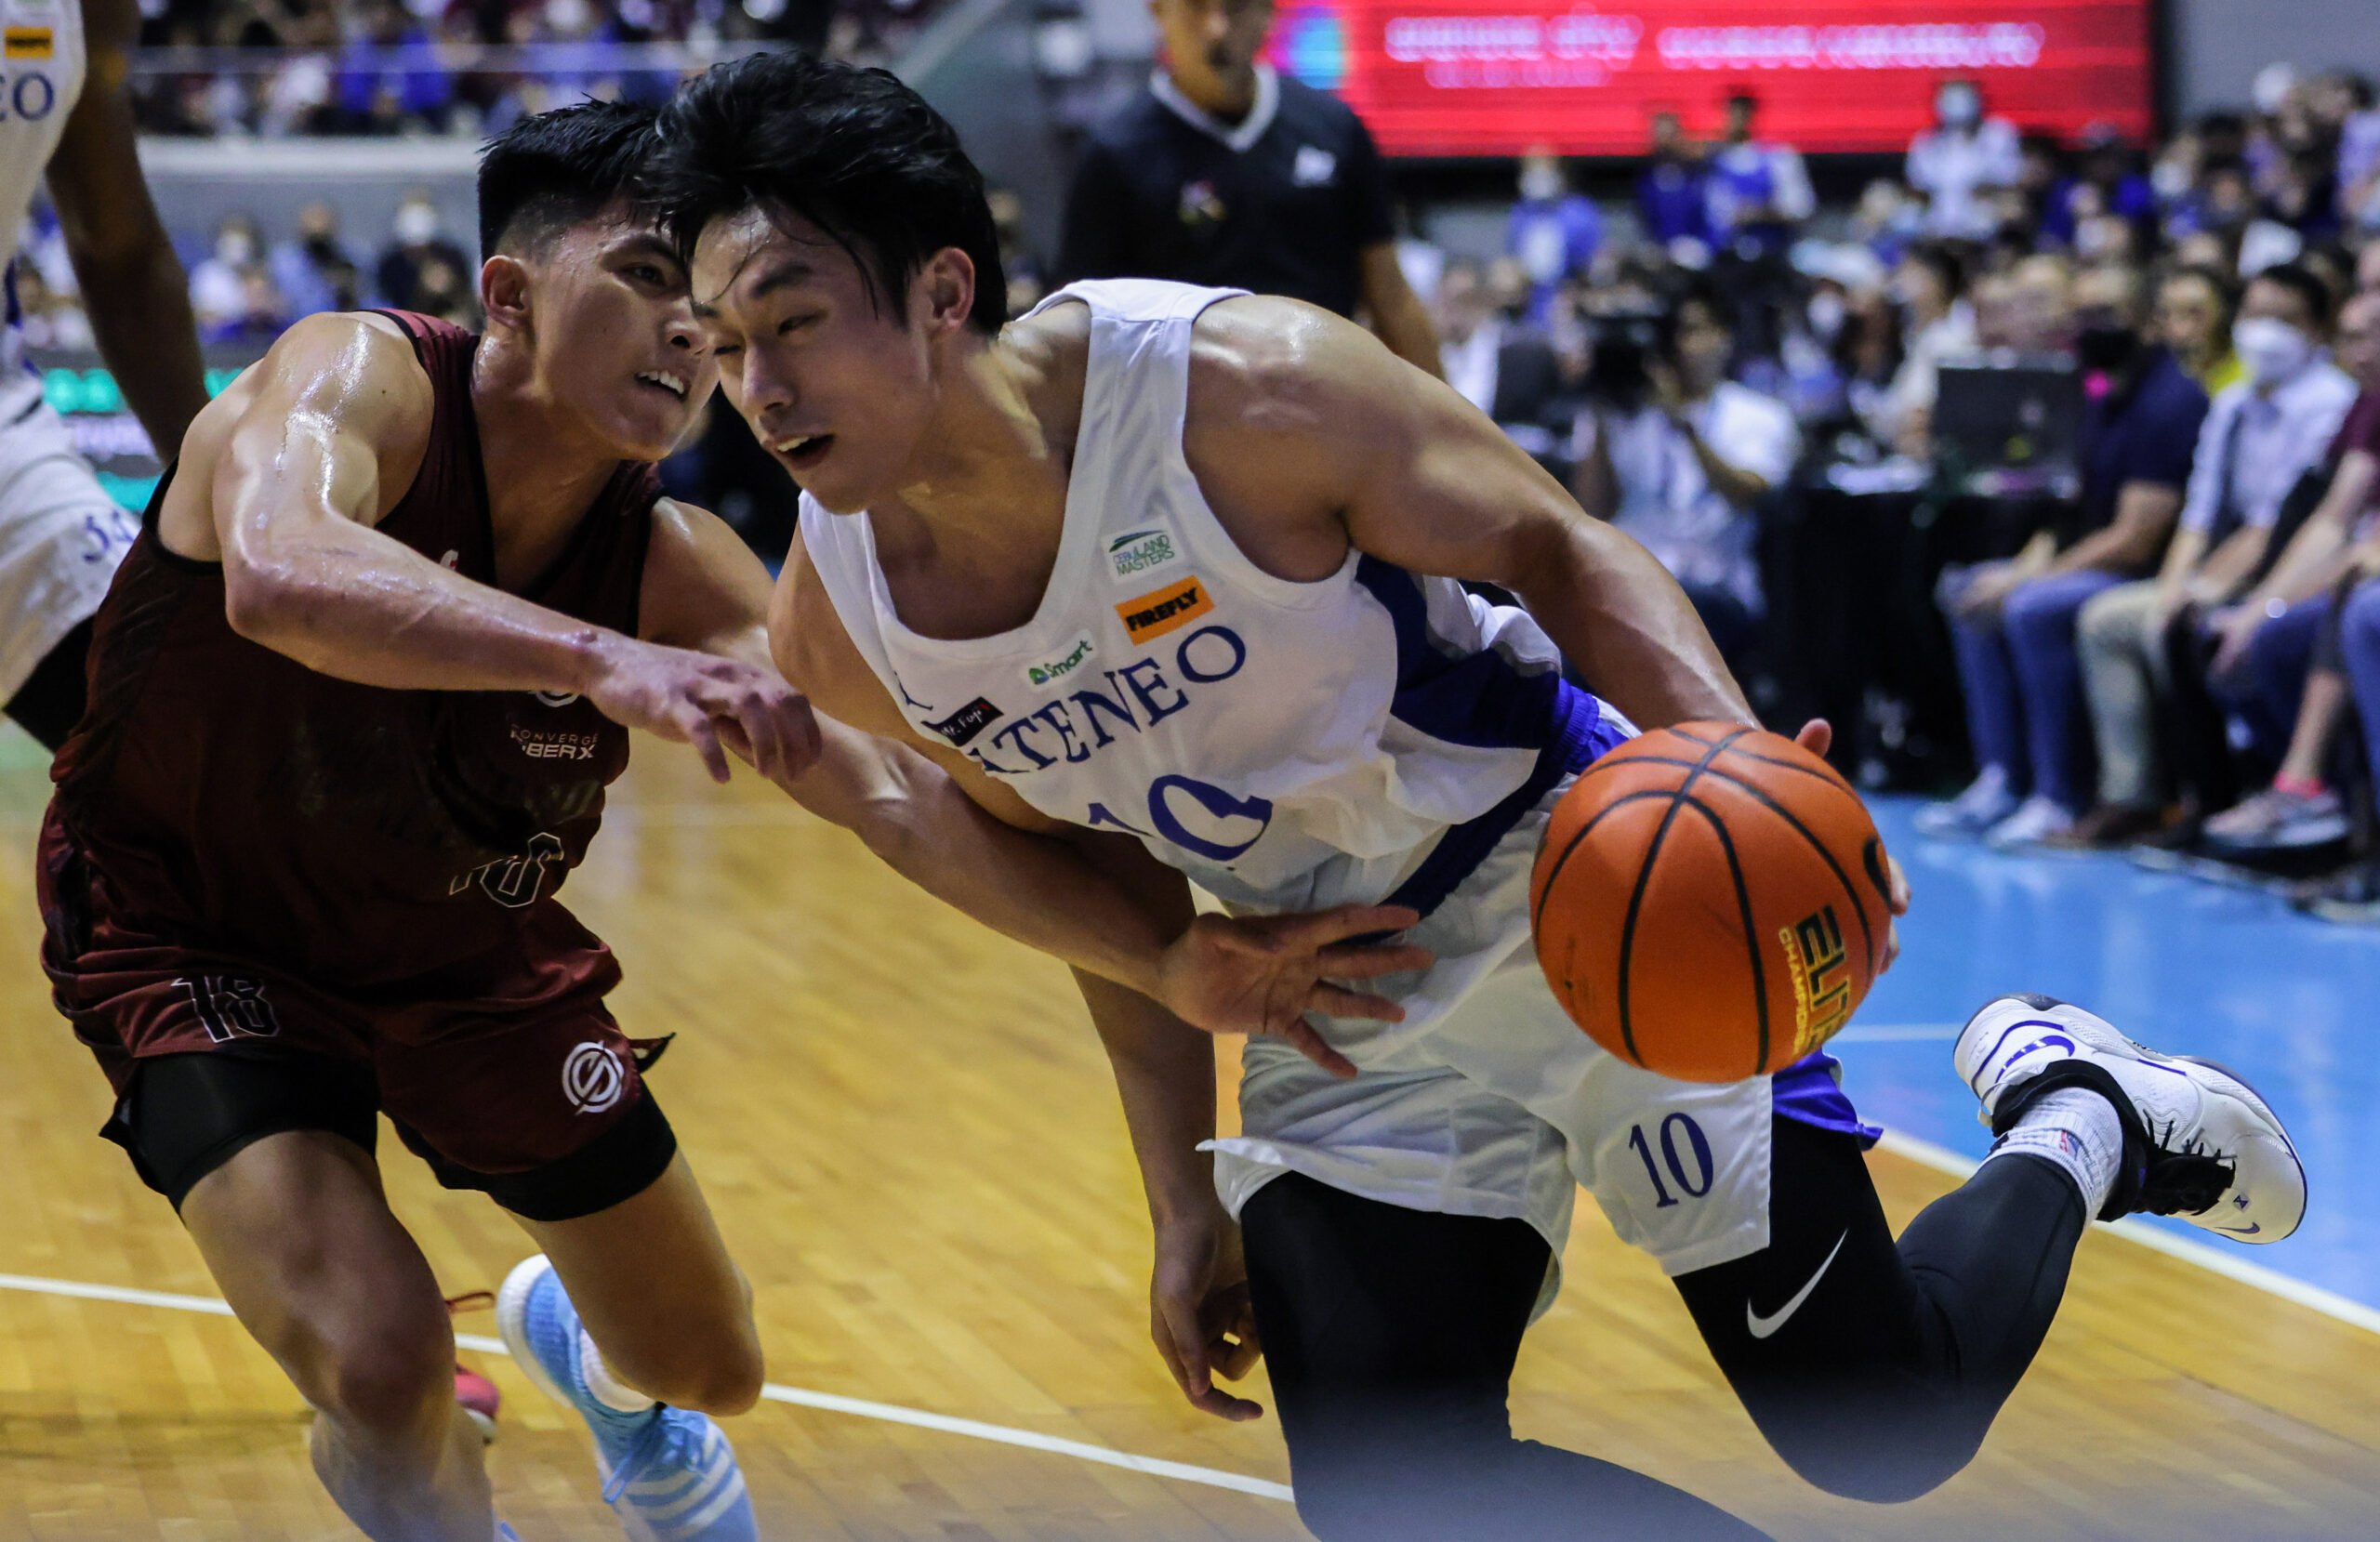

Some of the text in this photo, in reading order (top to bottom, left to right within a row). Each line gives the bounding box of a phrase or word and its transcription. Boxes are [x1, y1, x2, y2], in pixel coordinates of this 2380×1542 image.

[0, 72, 53, 122] O
[1117, 548, 1175, 576] MASTERS
[1126, 586, 1198, 632] FIREFLY
[1044, 639, 1092, 679] Smart
[522, 743, 595, 760] BERX
[170, 975, 280, 1044] 18
[1628, 1112, 1713, 1207] 10
